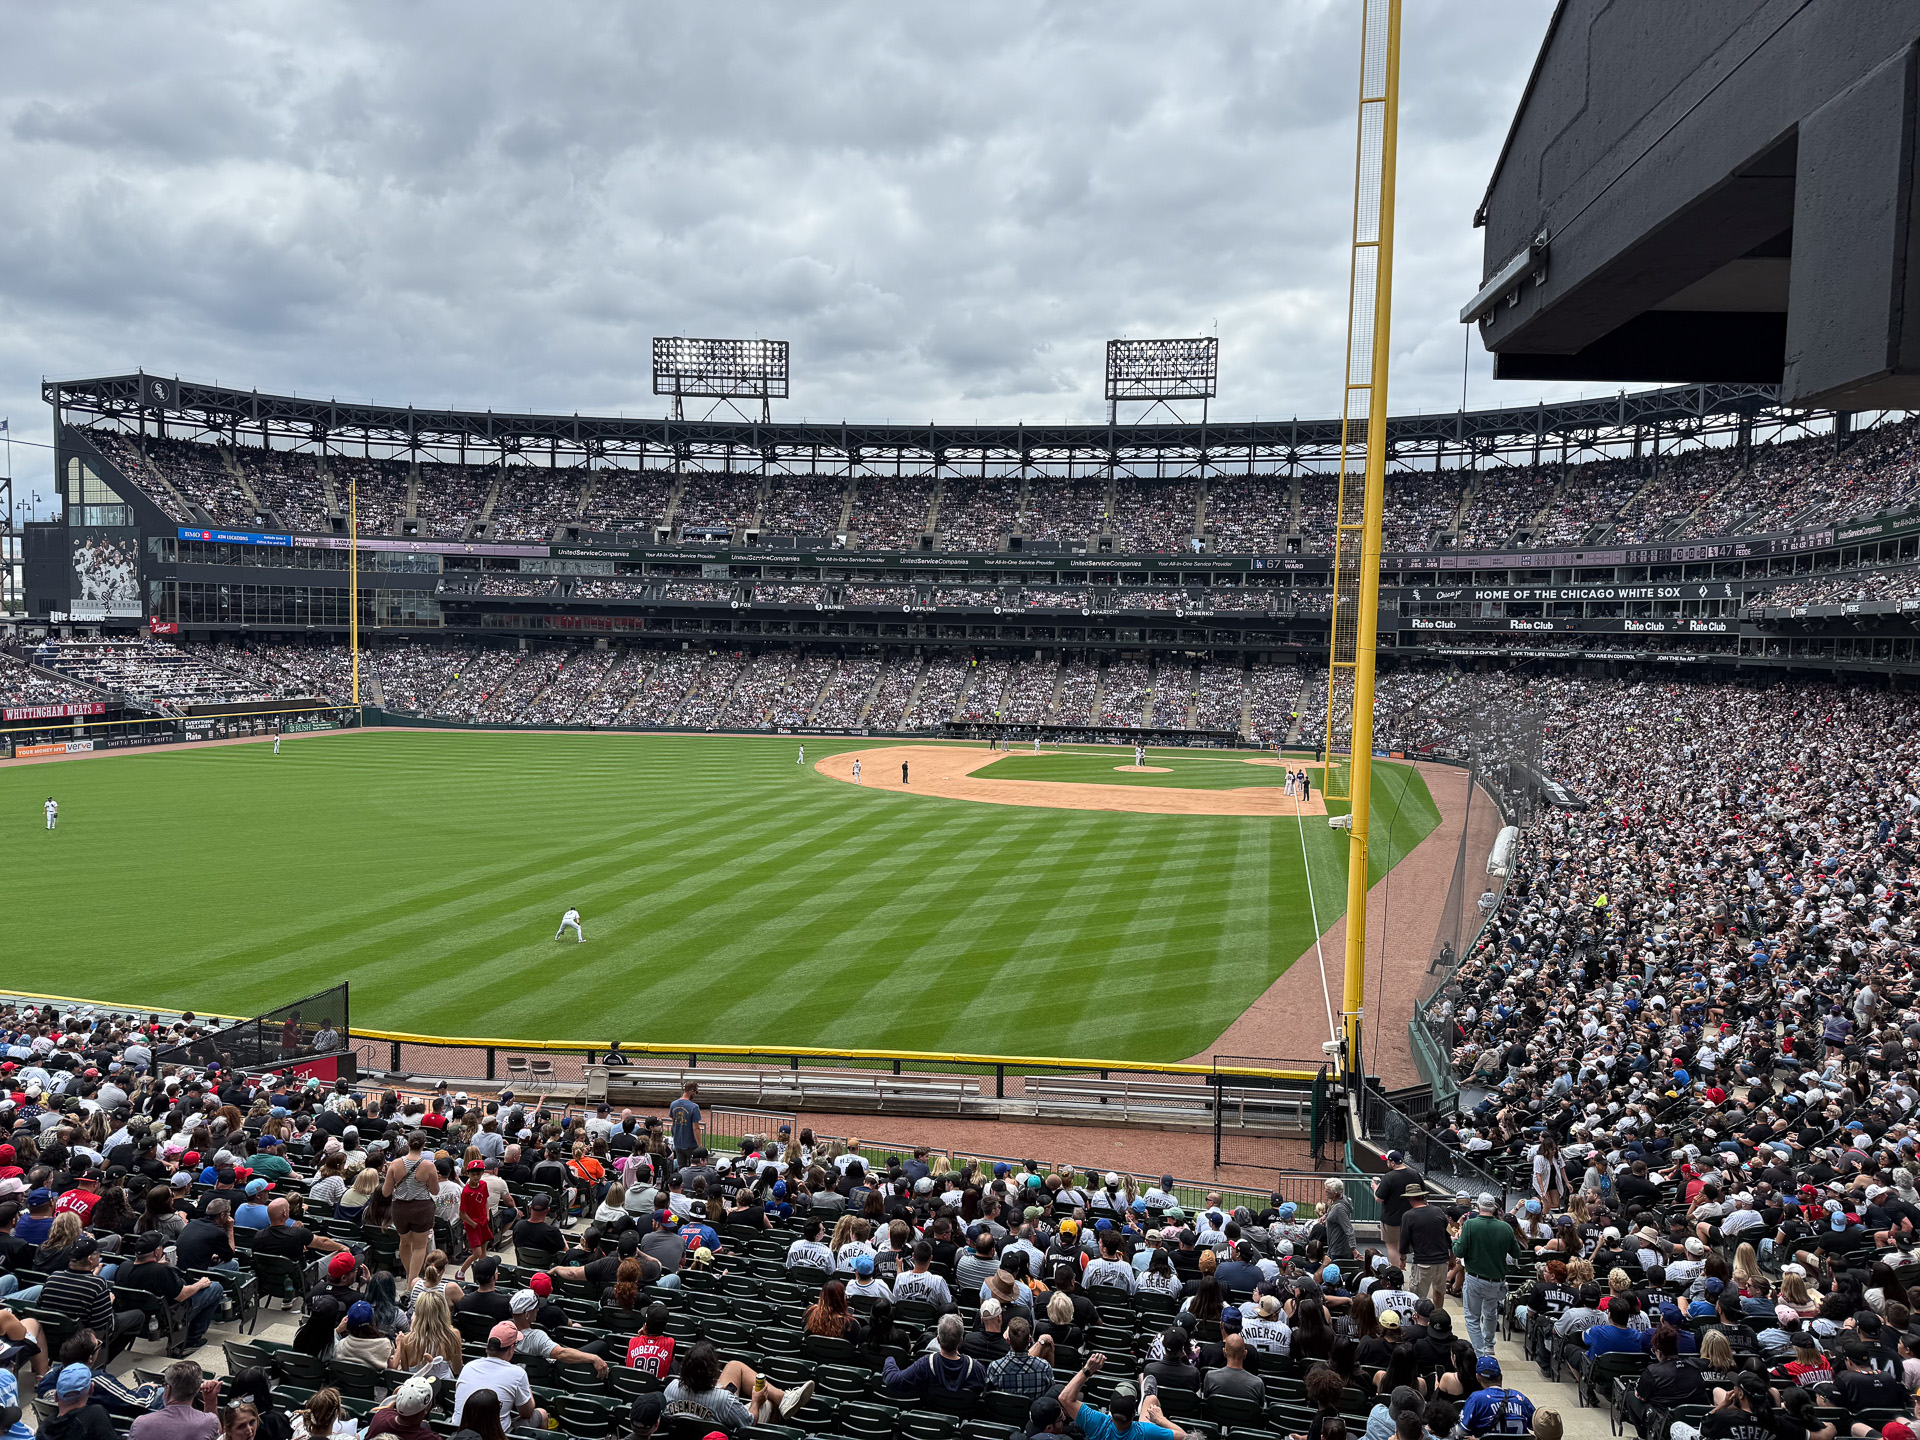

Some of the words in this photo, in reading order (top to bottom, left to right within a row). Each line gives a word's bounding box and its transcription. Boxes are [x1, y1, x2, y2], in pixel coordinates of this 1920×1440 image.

[558, 550, 629, 558] UnitedServiceCompanies
[1720, 546, 1732, 556] 47
[1266, 560, 1280, 570] 67
[1437, 590, 1462, 600] Chicago
[1476, 590, 1510, 599] HOME
[1514, 590, 1530, 599] OF
[1534, 590, 1557, 598] THE
[1560, 589, 1614, 598] CHICAGO
[1618, 588, 1653, 598] WHITE
[1658, 588, 1680, 597] SOX
[50, 611, 68, 623] Lite
[70, 614, 106, 622] LANDING
[1412, 619, 1434, 629] Rate
[1435, 621, 1456, 629] Club
[1510, 620, 1532, 629] Rate
[1534, 621, 1554, 630] Club
[1625, 620, 1644, 630] Rate
[1645, 621, 1665, 630] Club
[1690, 620, 1708, 630] Rate
[1709, 621, 1726, 631] Club
[6, 706, 64, 720] WHITTINGHAM
[66, 704, 92, 716] MEATS
[186, 732, 202, 740] Rate
[67, 742, 92, 752] verve
[70, 1198, 88, 1214] LEO
[791, 1250, 826, 1267] YOUKILIS
[840, 1249, 864, 1262] ANDER
[899, 1283, 932, 1297] JORDAN
[1575, 1315, 1607, 1330] MURAKA
[1240, 1327, 1287, 1345] ANDERSON
[630, 1345, 659, 1358] ROBERT
[633, 1356, 660, 1377] 88
[1870, 1358, 1896, 1379] 14
[1797, 1368, 1832, 1388] MURAKAM
